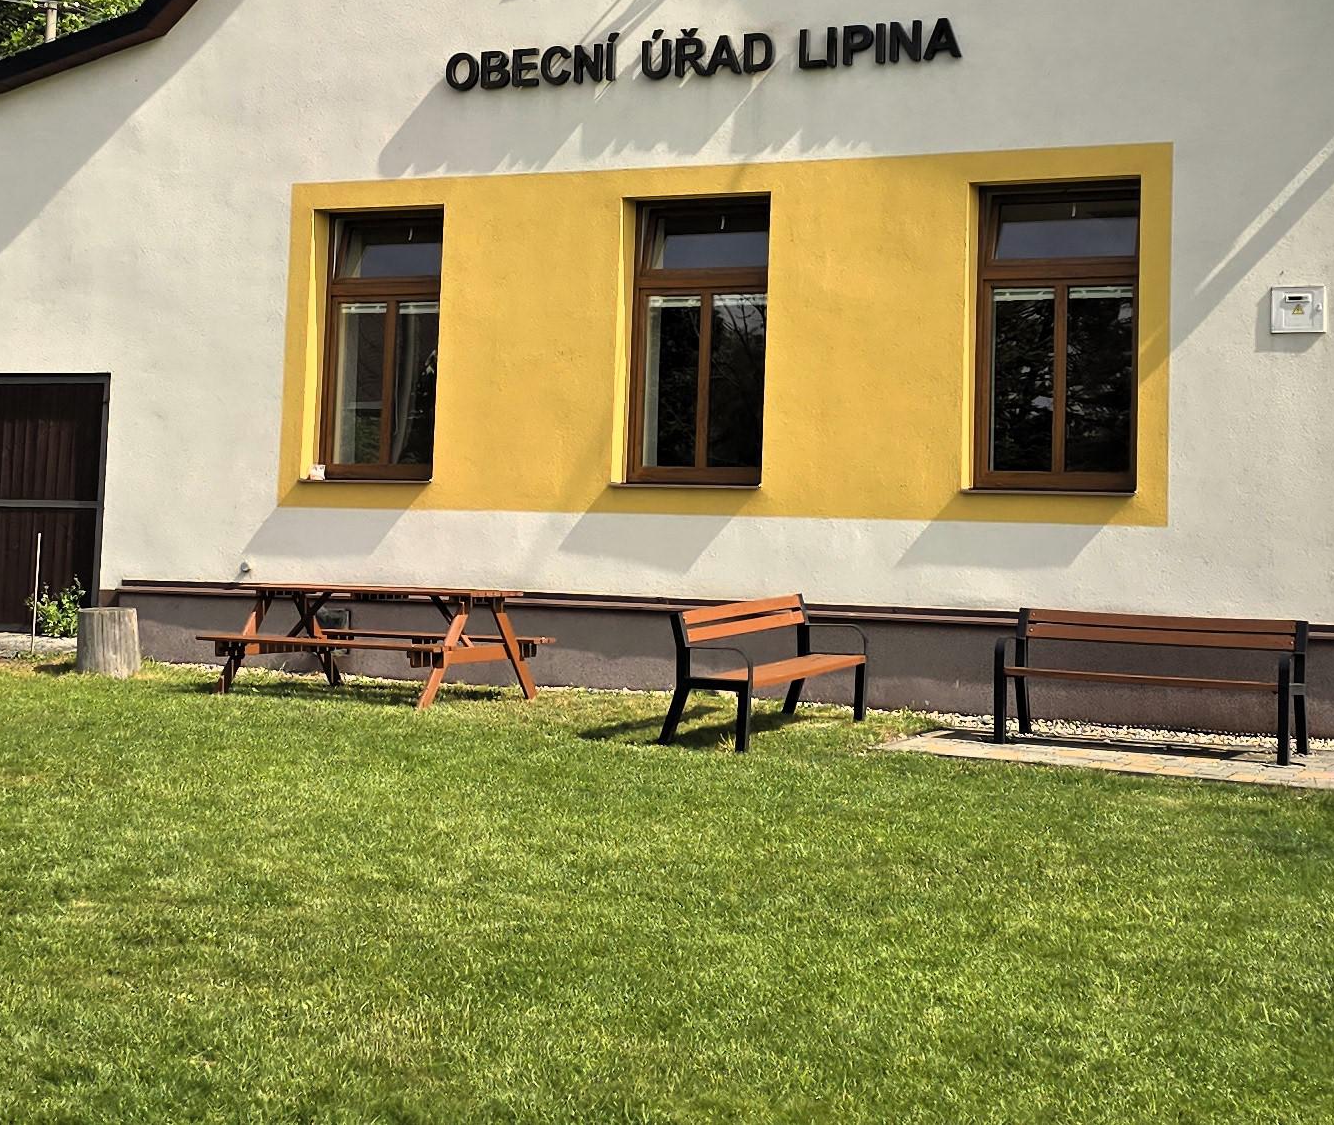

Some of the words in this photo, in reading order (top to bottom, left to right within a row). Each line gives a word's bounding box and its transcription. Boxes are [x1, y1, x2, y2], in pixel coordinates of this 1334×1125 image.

[445, 32, 621, 91] OBECNÍ
[640, 28, 774, 80] ÚŘAD
[798, 17, 962, 70] LIPINA
